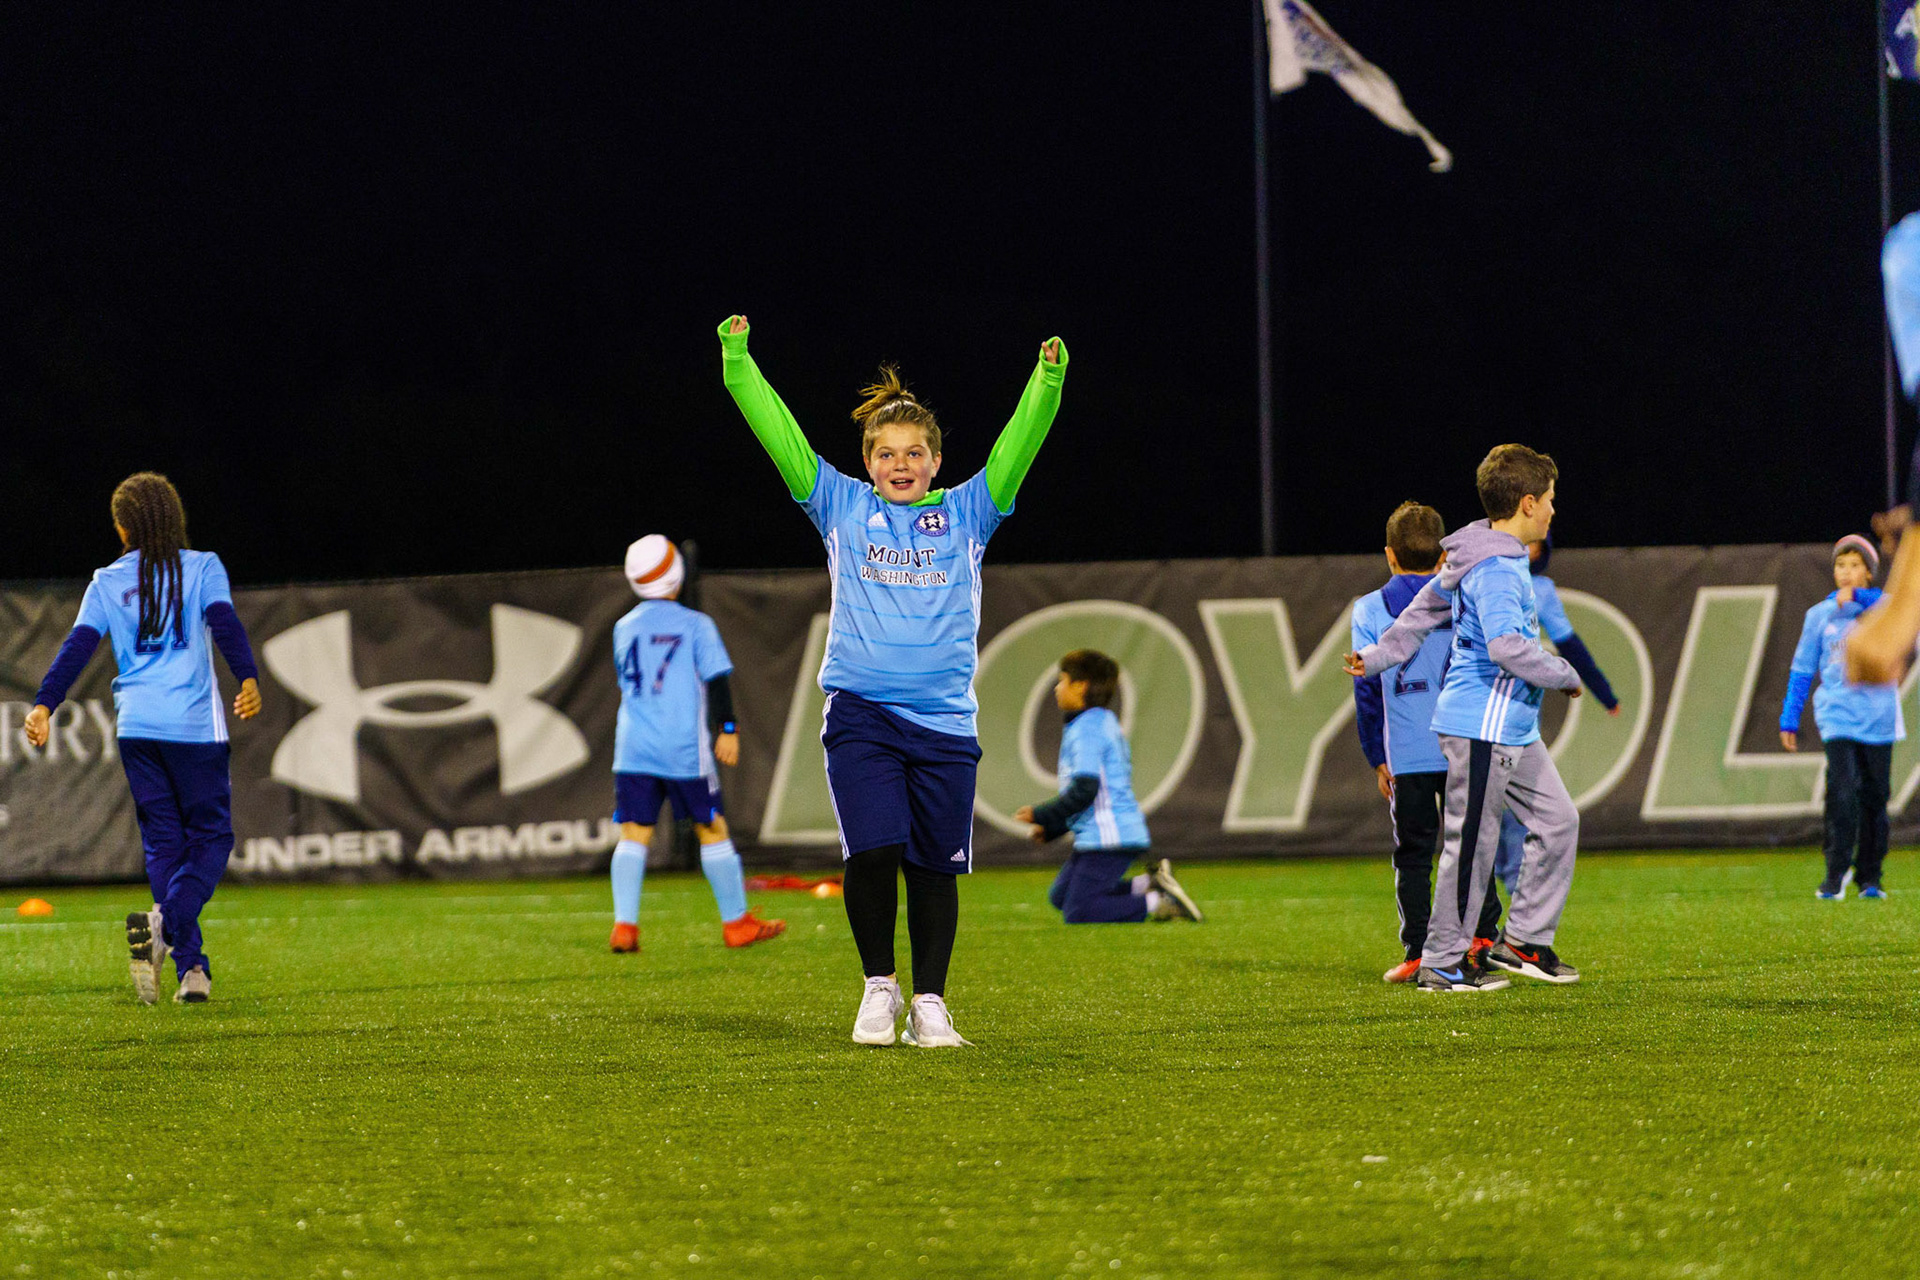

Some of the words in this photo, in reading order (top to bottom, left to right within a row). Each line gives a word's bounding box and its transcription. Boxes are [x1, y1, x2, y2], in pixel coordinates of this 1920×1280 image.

[861, 566, 948, 587] WASHINGTON
[866, 542, 936, 569] MOUNT
[622, 633, 683, 697] 47
[759, 584, 1920, 846] OYL
[227, 829, 403, 872] UNDER
[414, 816, 622, 865] ARMOU
